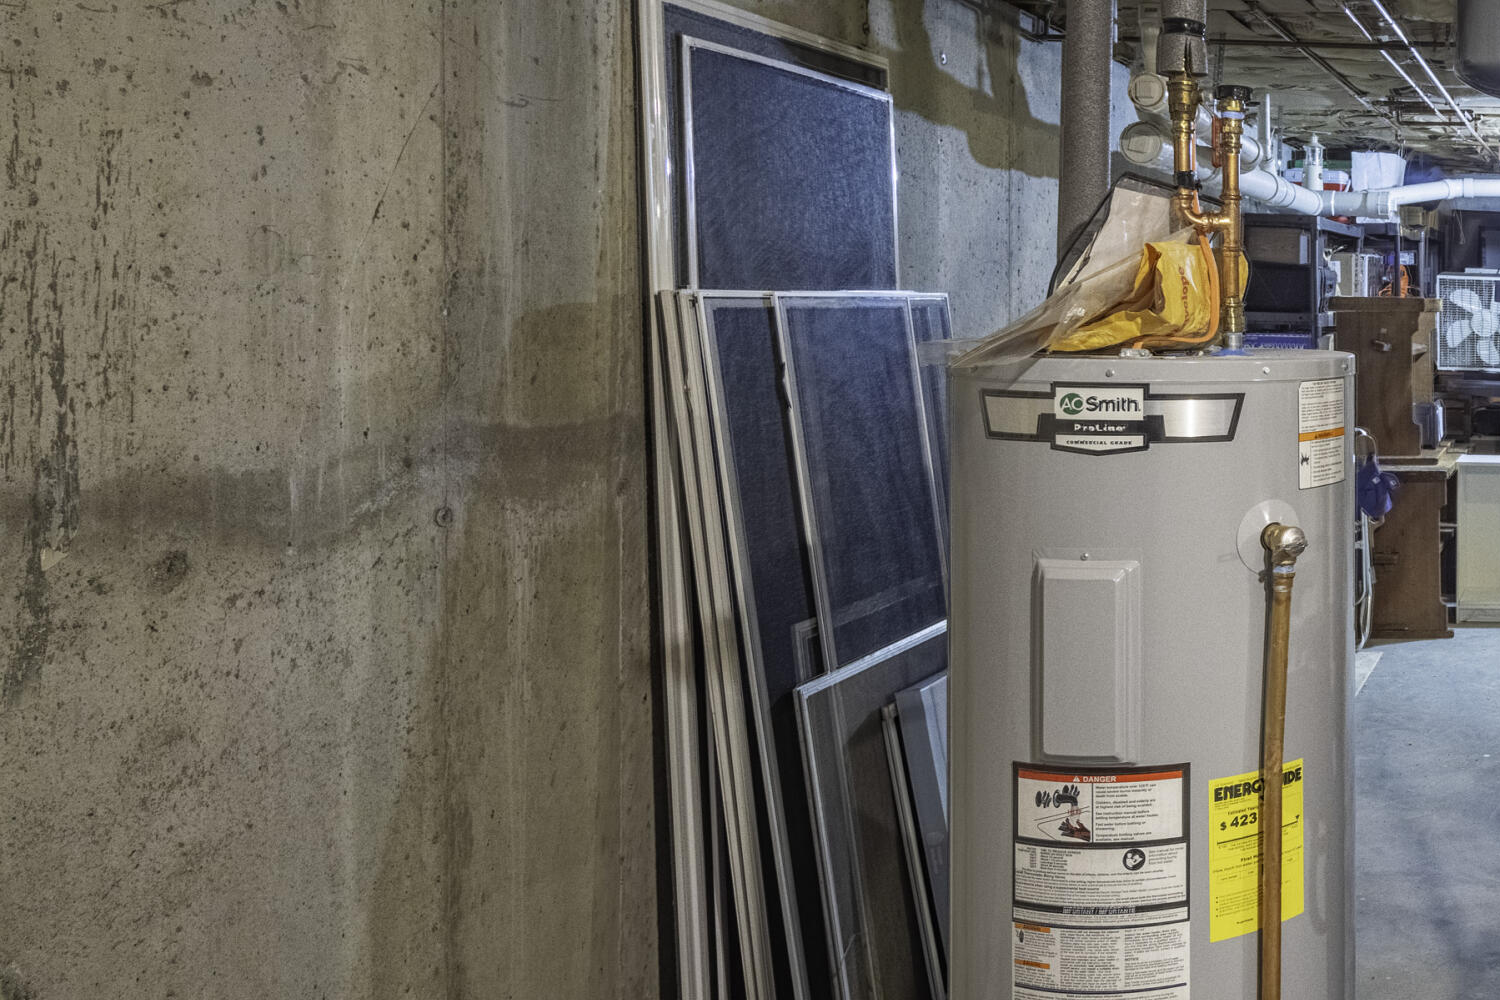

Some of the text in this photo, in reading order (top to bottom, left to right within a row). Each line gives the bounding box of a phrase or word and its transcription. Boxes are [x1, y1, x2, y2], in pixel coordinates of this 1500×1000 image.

[1086, 396, 1138, 412] Smith
[1074, 424, 1125, 432] ProLine
[1220, 812, 1258, 831] $ 423
